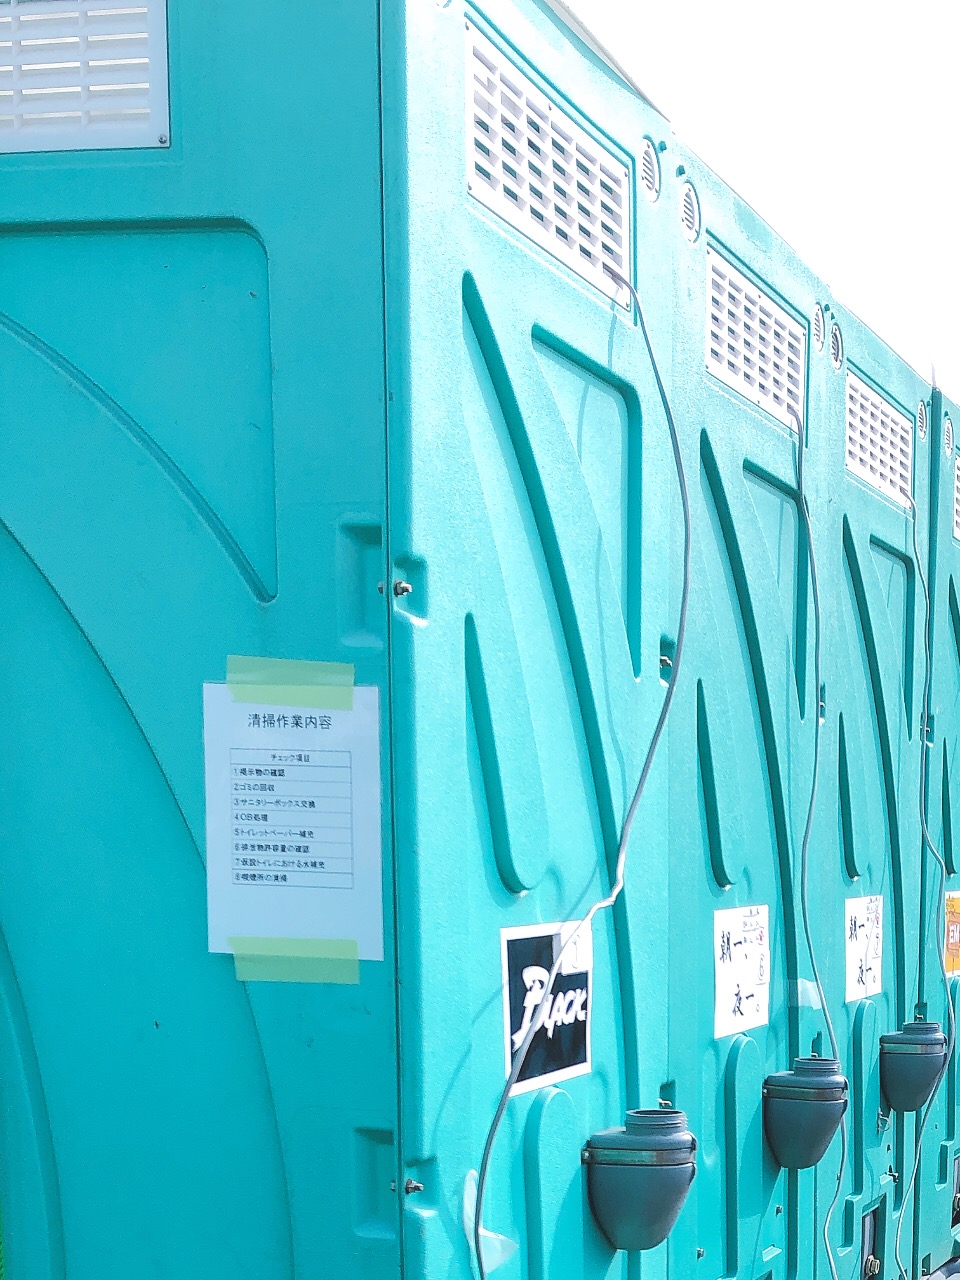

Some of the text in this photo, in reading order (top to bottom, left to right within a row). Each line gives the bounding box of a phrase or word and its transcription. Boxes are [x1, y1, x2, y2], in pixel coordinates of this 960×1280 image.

[247, 713, 333, 730] 清掃作業内容
[270, 753, 311, 763] チェック項目
